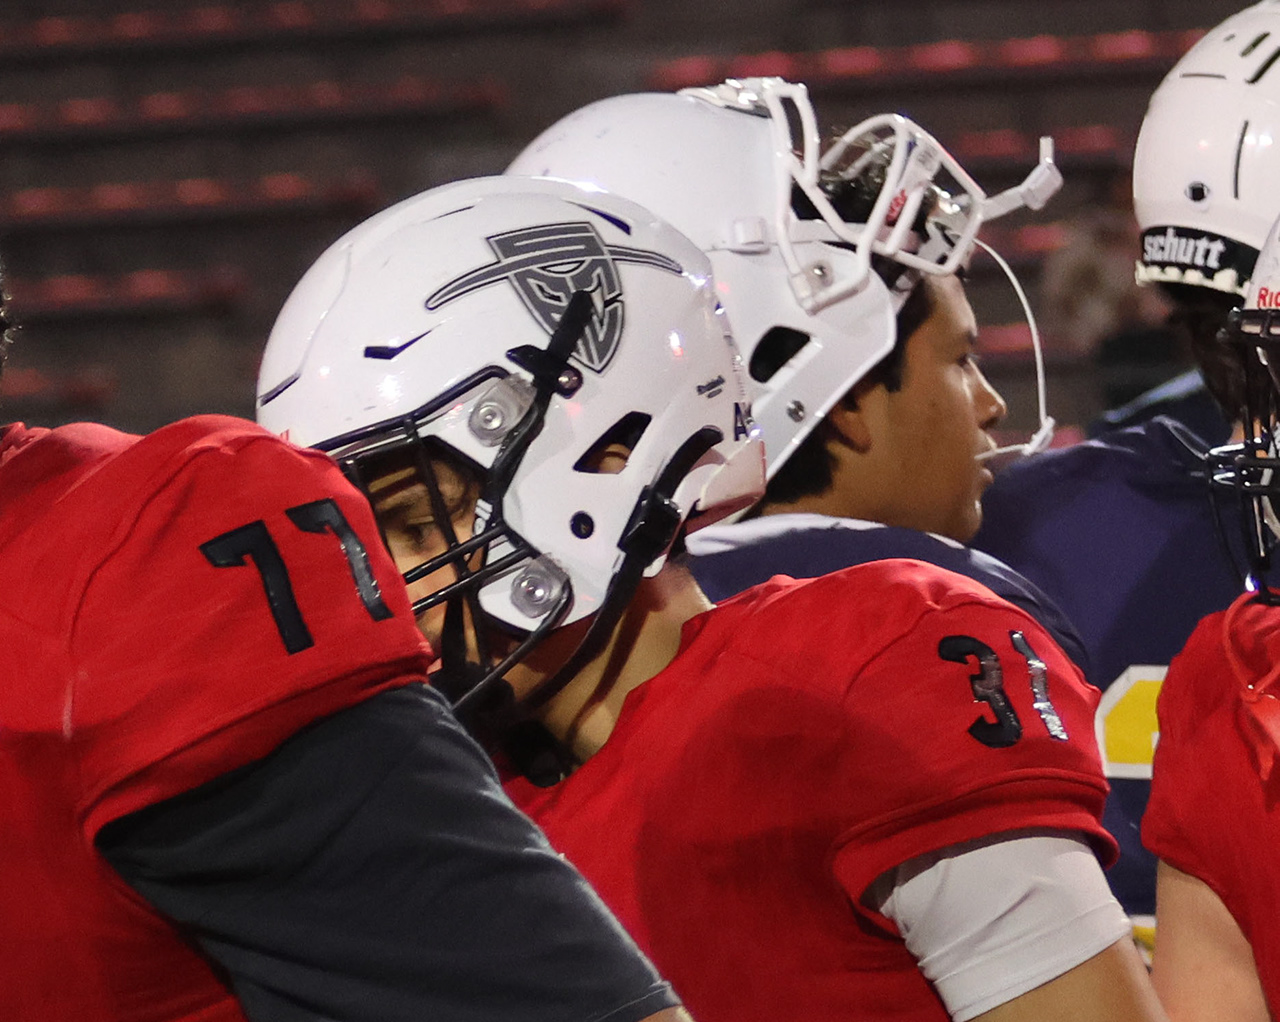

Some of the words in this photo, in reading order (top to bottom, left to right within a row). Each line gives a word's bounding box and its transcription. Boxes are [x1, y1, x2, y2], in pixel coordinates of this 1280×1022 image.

[1143, 227, 1226, 269] schutt
[198, 498, 394, 655] 77
[938, 630, 1068, 748] 31
